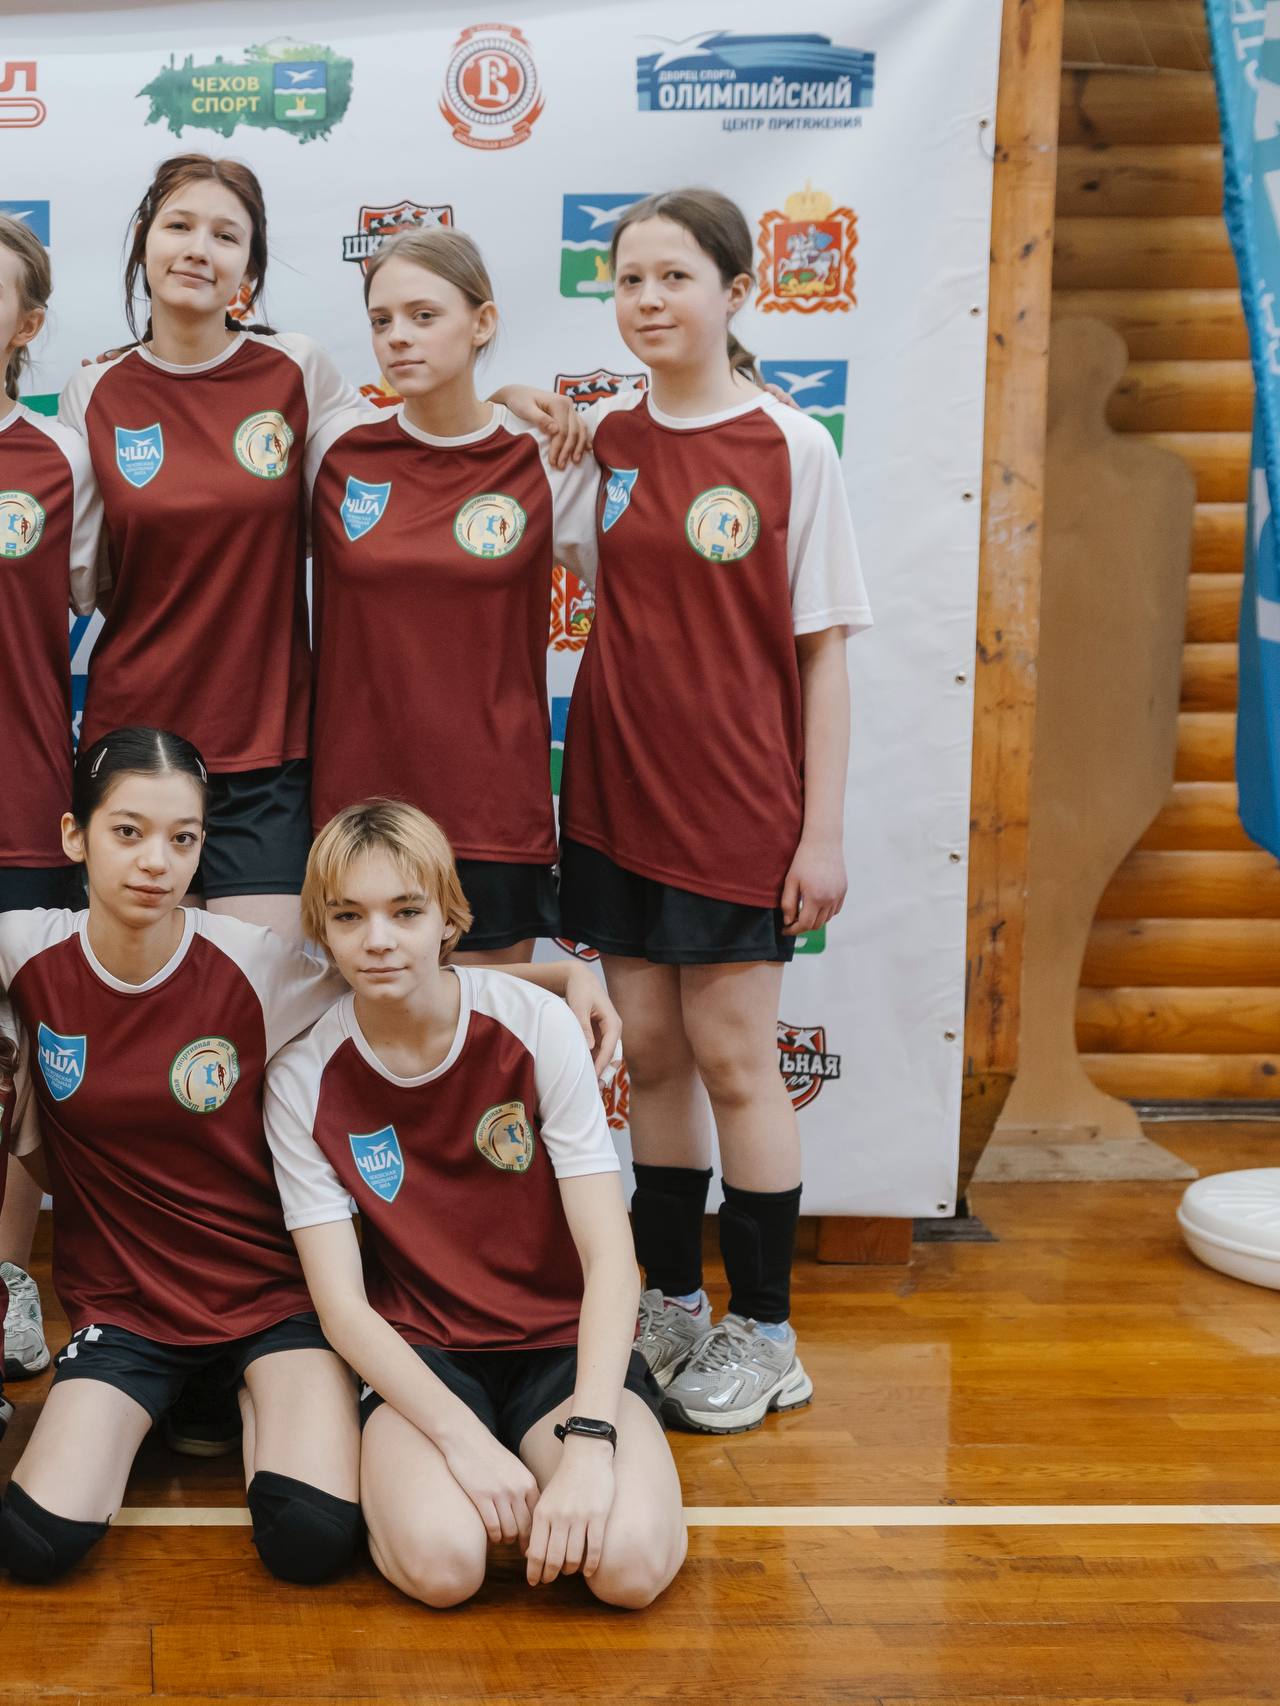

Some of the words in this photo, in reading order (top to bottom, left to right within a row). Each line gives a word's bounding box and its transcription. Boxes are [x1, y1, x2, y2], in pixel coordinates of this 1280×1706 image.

[192, 76, 260, 92] ЧЕХОВ
[658, 76, 852, 109] ОЛИМПИЙСКИЙ
[192, 96, 261, 112] СПОРТ
[722, 117, 765, 132] ЦЕНТР
[769, 116, 862, 130] ПРИТЯЖЕНИЯ
[119, 446, 160, 461] ЧШЛ
[347, 498, 379, 516] ЧШЛ
[41, 1046, 80, 1077] ЧШЛ
[782, 1053, 839, 1076] ЬНАЯ
[357, 1150, 400, 1172] ЧШЛ
